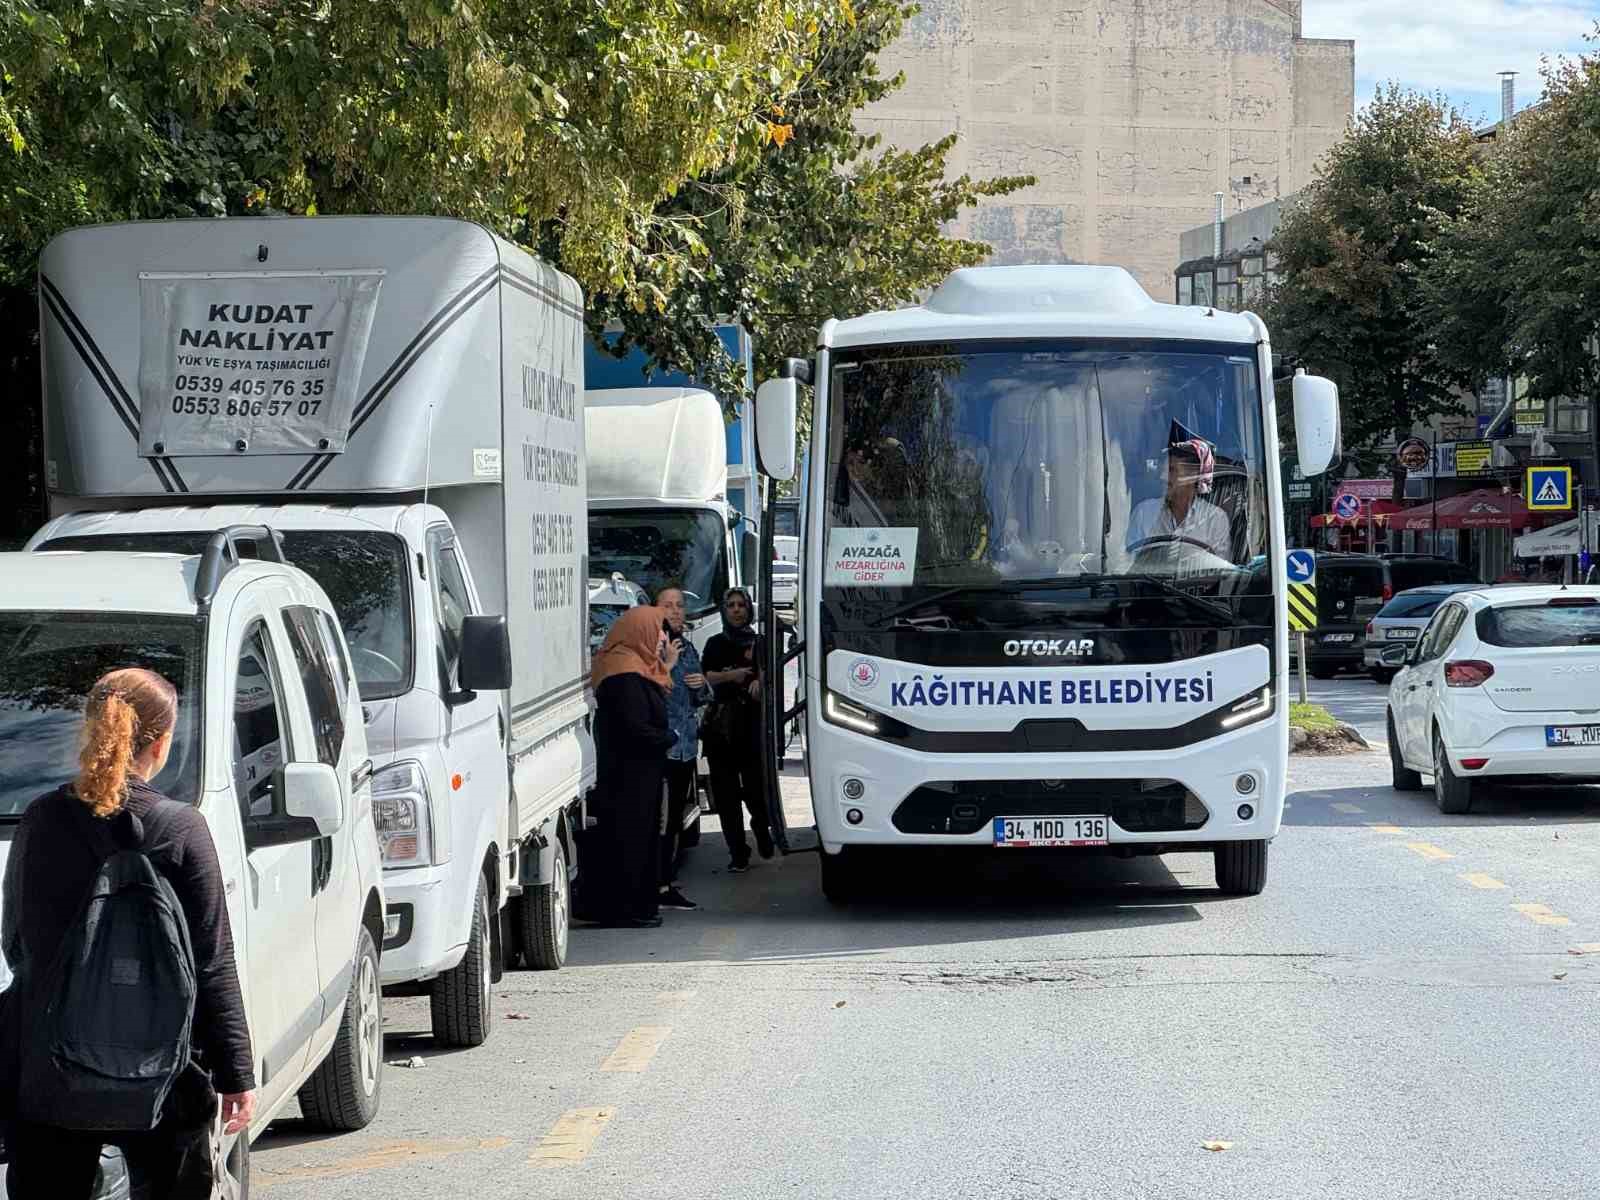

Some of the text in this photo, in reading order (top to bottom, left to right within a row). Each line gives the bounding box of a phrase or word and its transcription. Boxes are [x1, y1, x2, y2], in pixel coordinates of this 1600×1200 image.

[208, 304, 313, 324] KUDAT
[179, 328, 334, 351] NAKLİYAT
[177, 354, 331, 372] YÜK VE EŞYA TAŞIMACILIĞI
[175, 375, 325, 396] 0539 405 76 35
[172, 395, 322, 416] 0553 806 57 07
[842, 544, 901, 558] AYAZAĞA
[835, 560, 906, 571] MEZARLIĞINA
[854, 571, 885, 581] GİDER
[1003, 639, 1095, 656] OTOKAR
[891, 671, 1213, 706] KÂĞITHANE BELEDİYESİ
[1555, 728, 1570, 742] 34
[1005, 820, 1103, 840] 34 MDD 136
